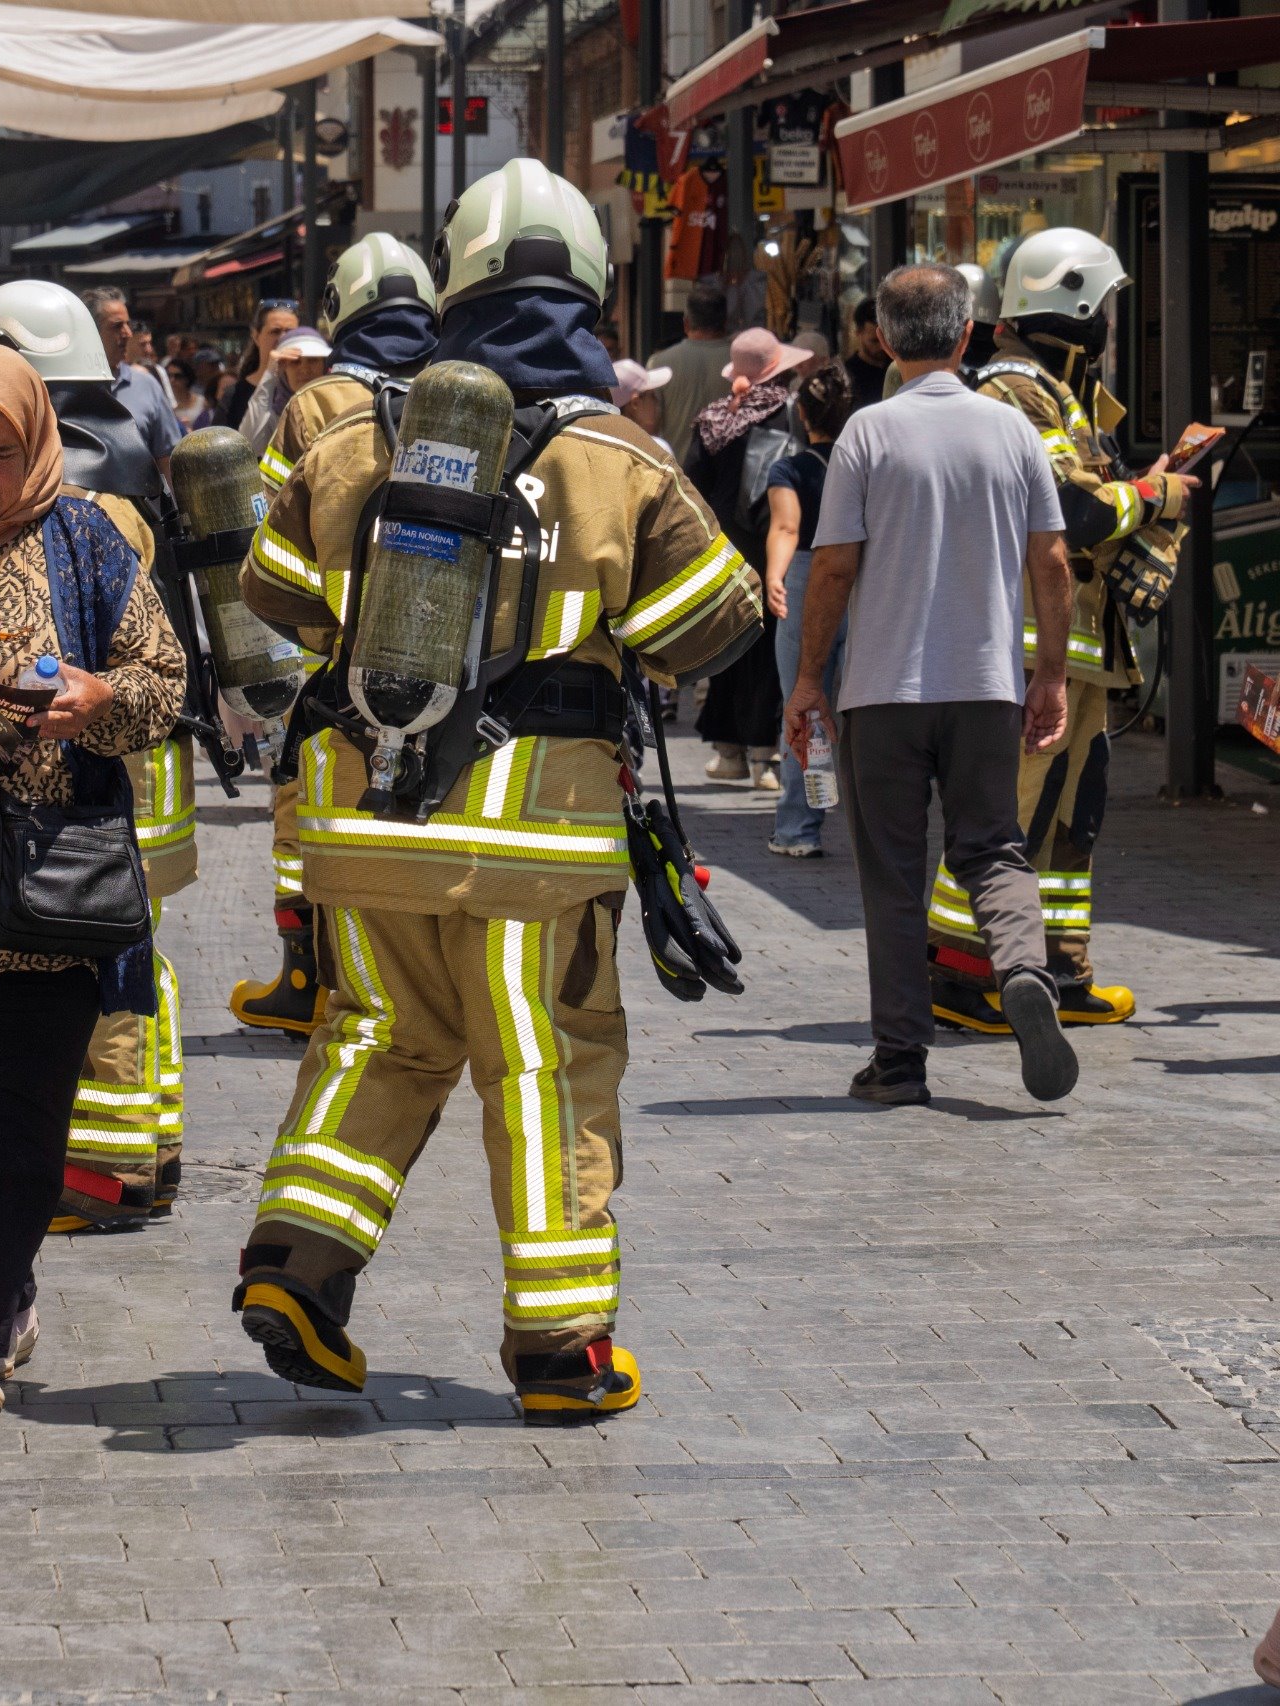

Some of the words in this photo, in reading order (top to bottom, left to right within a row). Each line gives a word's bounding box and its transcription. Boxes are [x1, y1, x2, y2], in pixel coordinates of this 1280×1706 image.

[669, 131, 688, 168] 7
[401, 529, 417, 541] BAR
[418, 531, 456, 547] NOMINAL
[9, 703, 35, 713] ATMA
